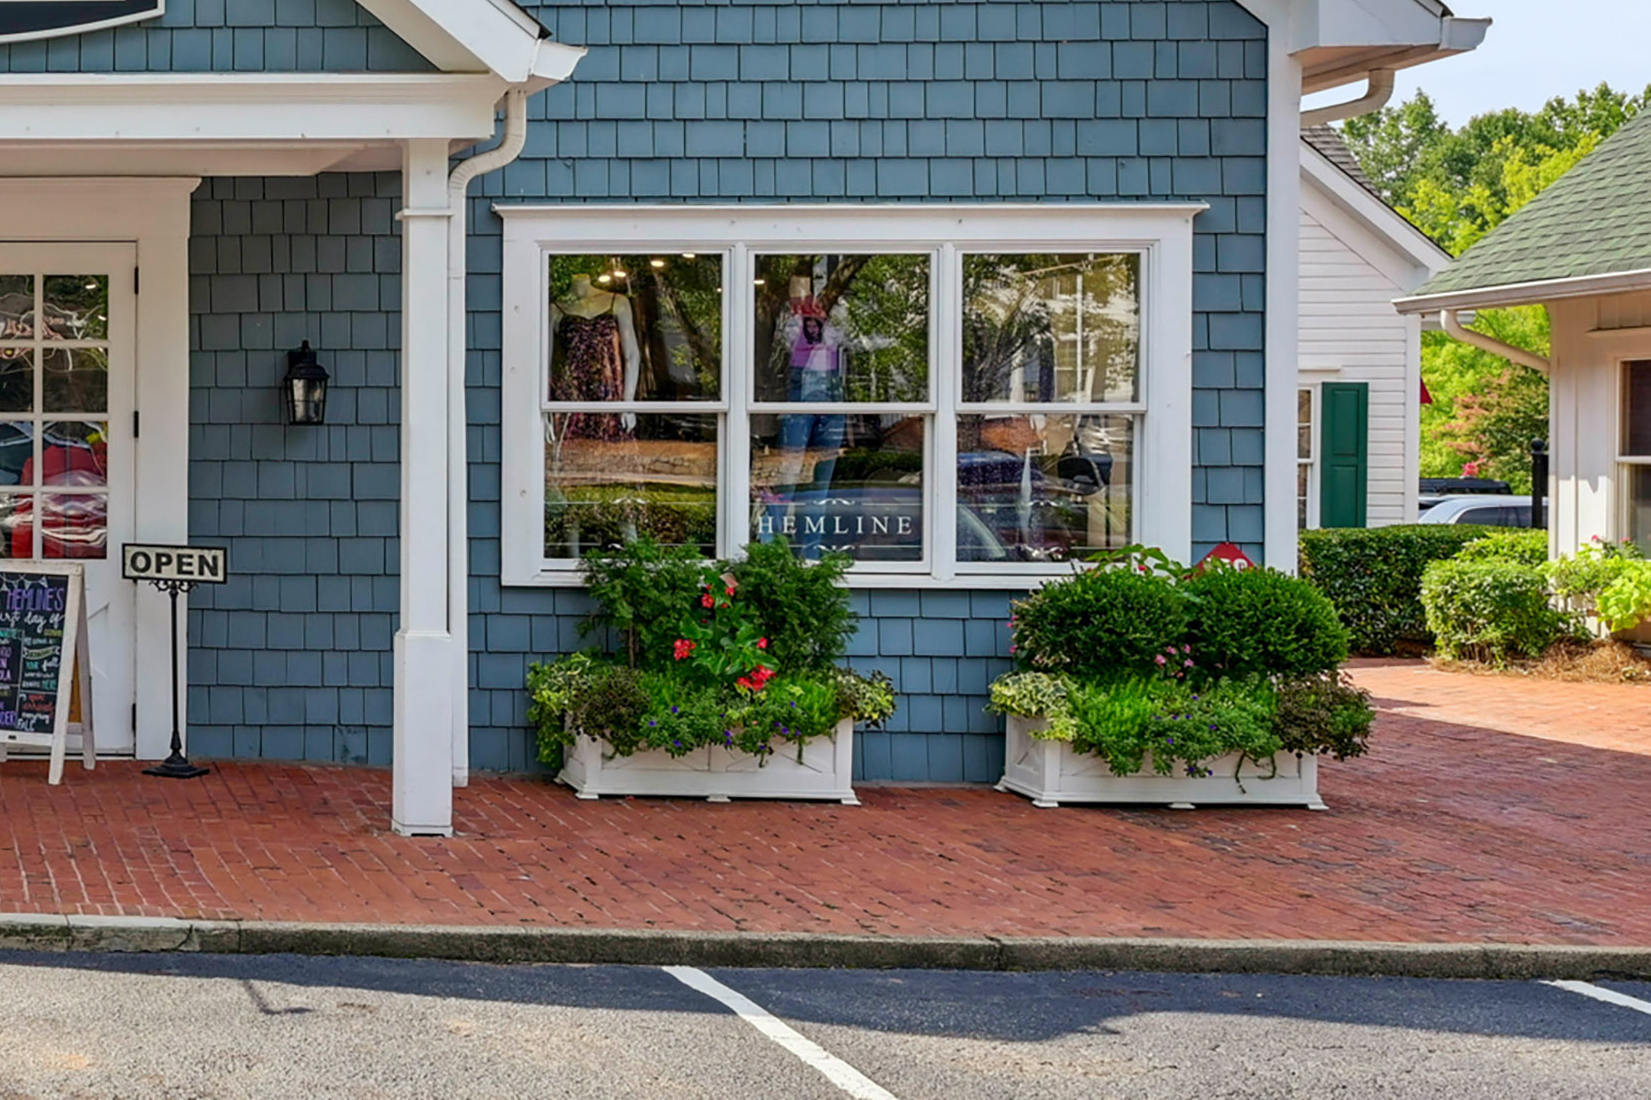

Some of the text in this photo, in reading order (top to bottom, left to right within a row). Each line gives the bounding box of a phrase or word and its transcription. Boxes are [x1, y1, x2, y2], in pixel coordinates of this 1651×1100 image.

[757, 515, 913, 535] HEMLINE
[130, 551, 219, 577] OPEN
[24, 611, 47, 633] day
